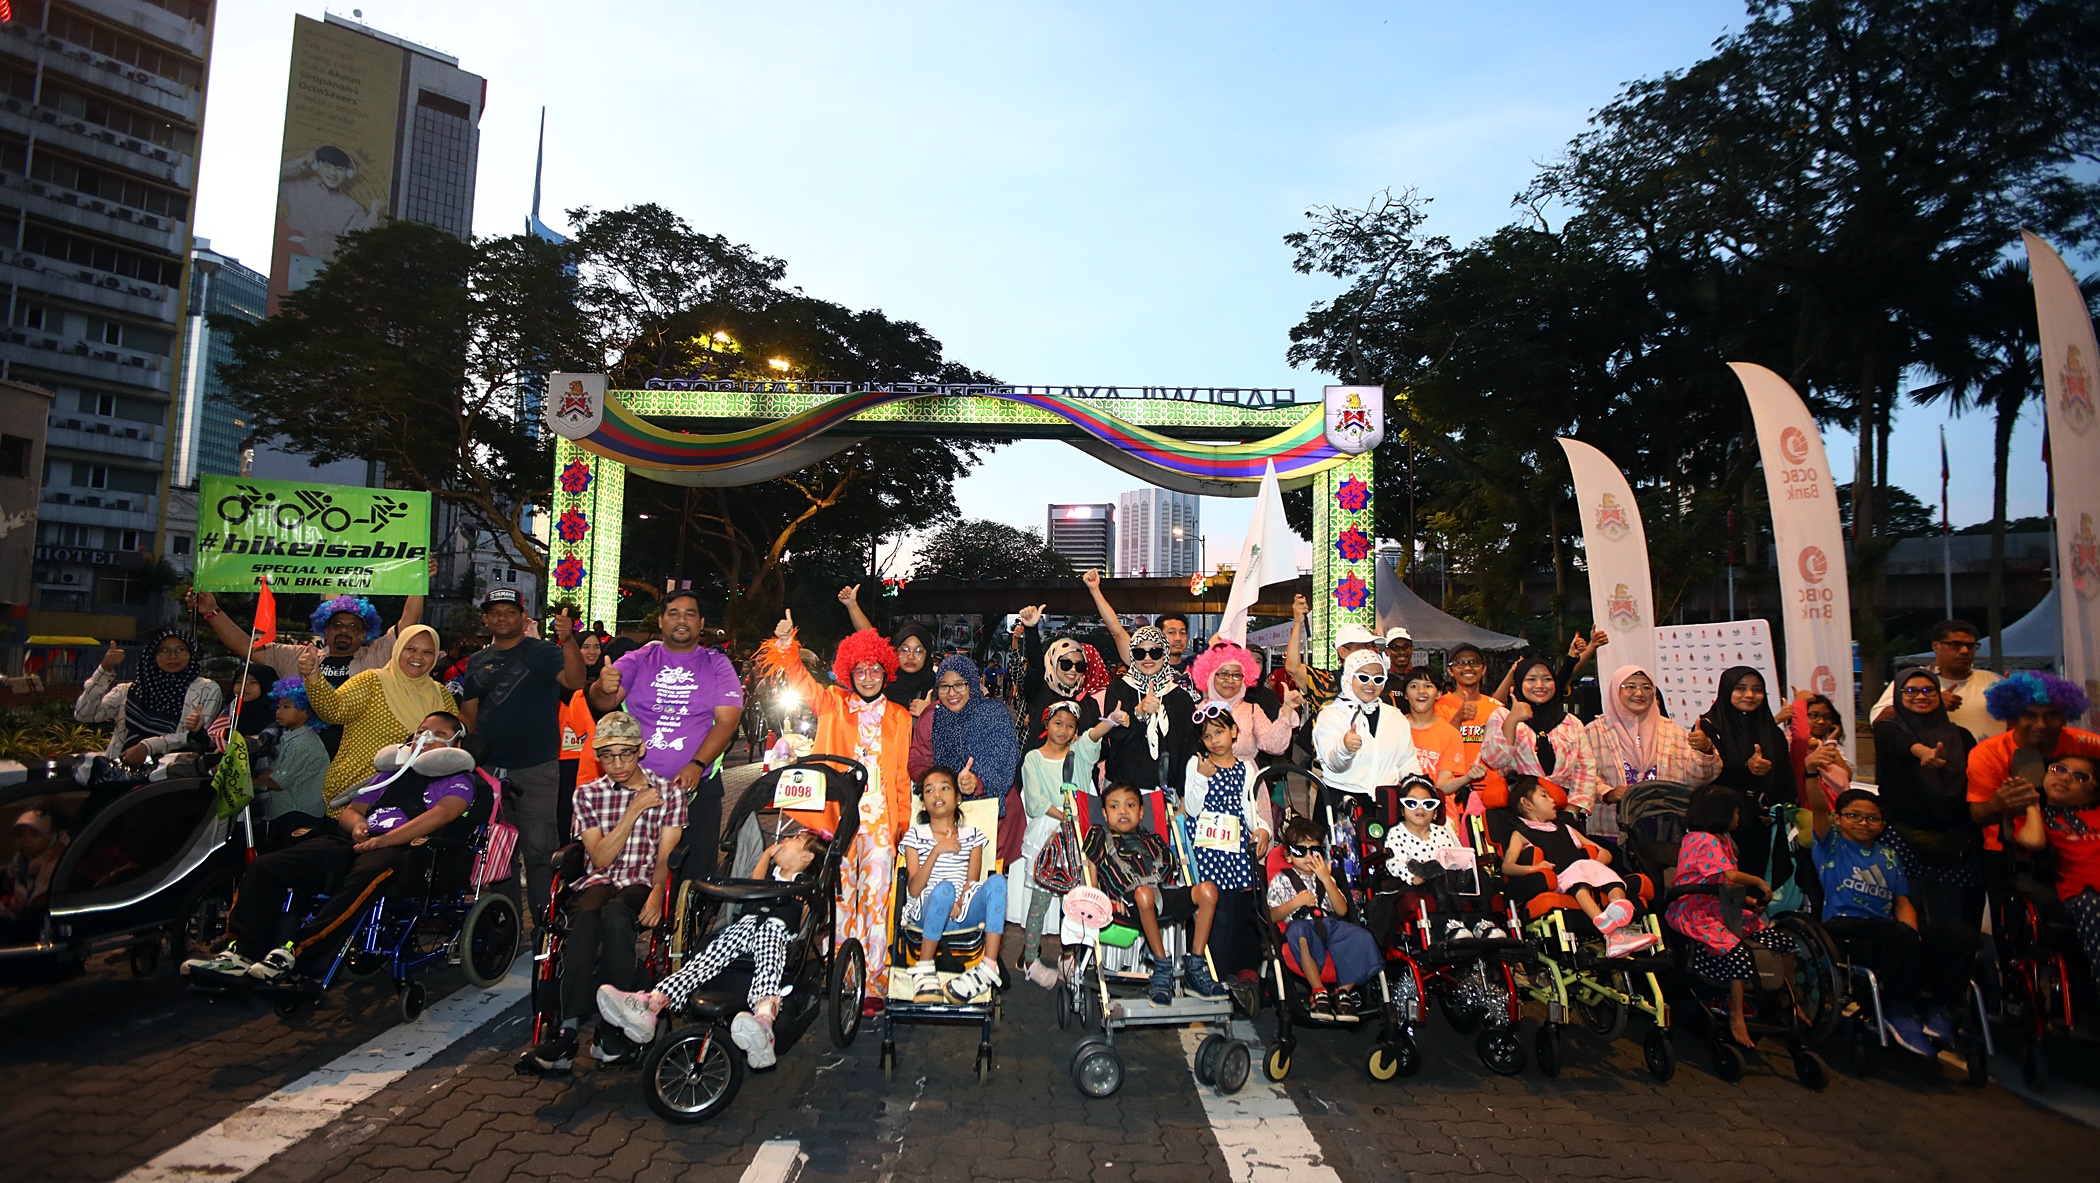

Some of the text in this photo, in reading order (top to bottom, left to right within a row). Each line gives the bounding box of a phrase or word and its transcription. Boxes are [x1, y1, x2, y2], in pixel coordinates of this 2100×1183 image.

[327, 69, 361, 85] Akaun
[198, 532, 428, 561] #bikeisable
[35, 547, 120, 566] HOTEL
[251, 564, 374, 576] SPECIAL NEEDS
[254, 577, 371, 588] RUN BIKE RUN
[784, 785, 812, 798] 0098
[1843, 878, 1893, 900] adidas
